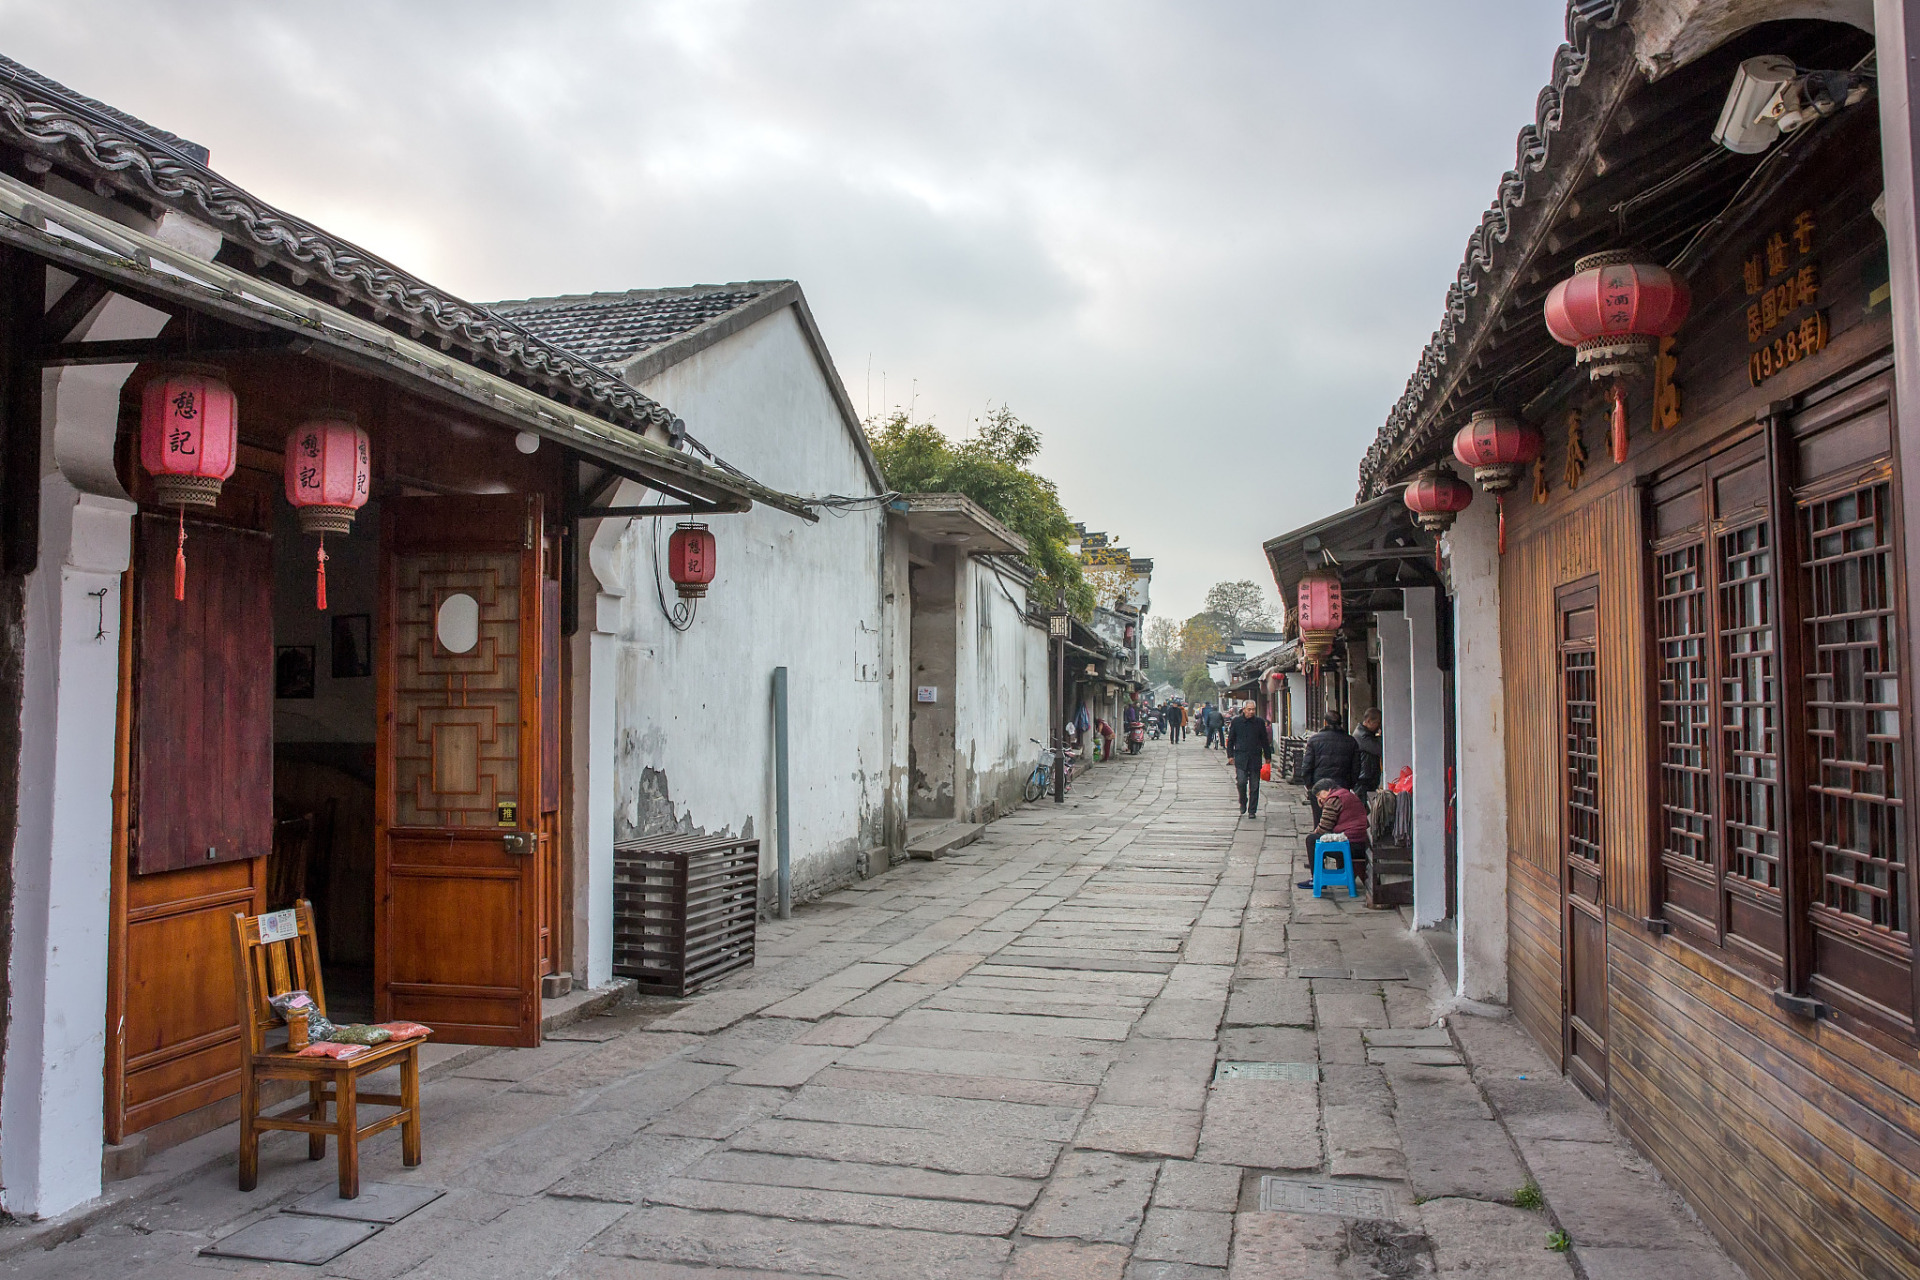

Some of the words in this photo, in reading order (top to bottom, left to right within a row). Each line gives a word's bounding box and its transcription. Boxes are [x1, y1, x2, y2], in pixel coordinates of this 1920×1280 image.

[1746, 265, 1820, 343] 民国27年
[1748, 310, 1826, 388] (1938年)
[502, 808, 513, 819] 推
